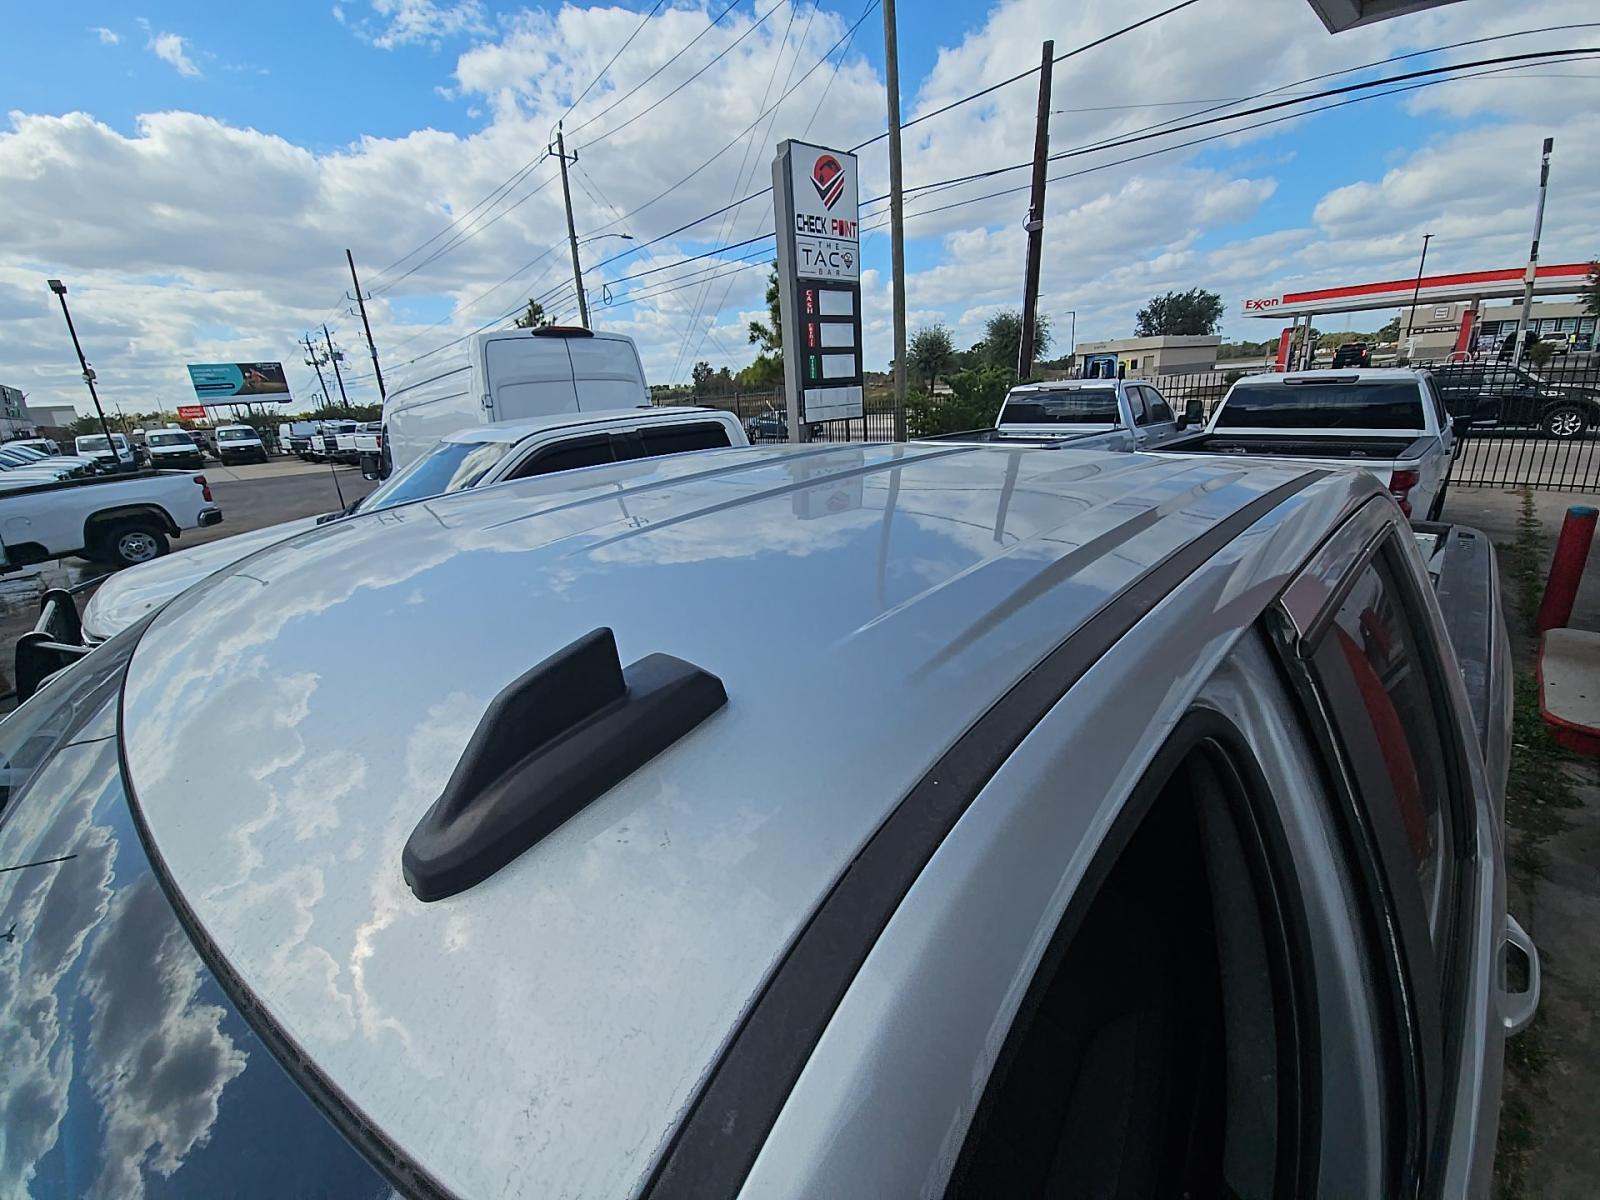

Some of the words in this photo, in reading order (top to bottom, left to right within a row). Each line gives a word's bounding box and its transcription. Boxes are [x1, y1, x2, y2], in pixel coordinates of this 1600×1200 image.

[796, 213, 827, 235] CHECK
[818, 241, 840, 251] THE
[818, 268, 840, 277] BAR
[1245, 298, 1279, 311] Exxon
